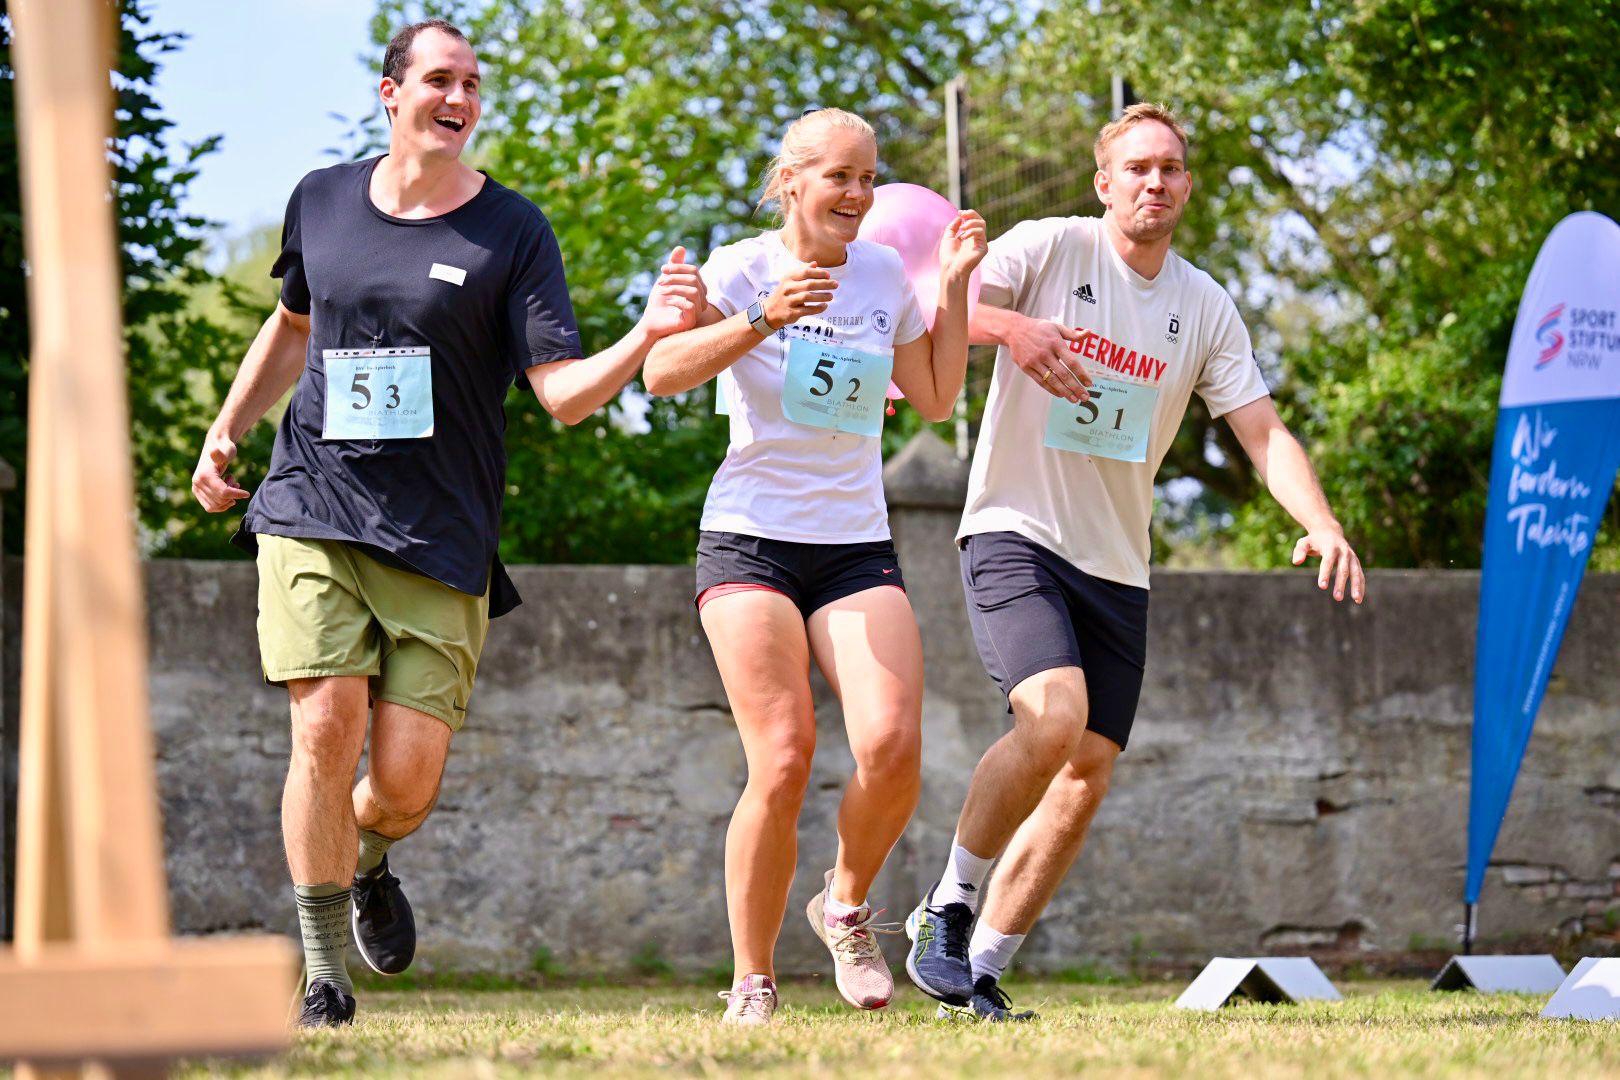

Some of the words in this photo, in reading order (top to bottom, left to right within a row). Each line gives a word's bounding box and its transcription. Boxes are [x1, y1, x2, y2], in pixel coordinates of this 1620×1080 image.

[1073, 289, 1097, 305] adidas
[828, 316, 864, 327] GERMANY
[1570, 307, 1616, 329] SPORT
[1069, 327, 1168, 382] GERMANY
[351, 373, 371, 410] 5
[385, 384, 401, 409] 3
[810, 358, 836, 397] 5
[845, 377, 861, 403] 2
[826, 398, 869, 412] BIATHLON
[1075, 390, 1102, 425] 5
[1111, 408, 1125, 431] 1
[1089, 429, 1134, 442] BIATHLON
